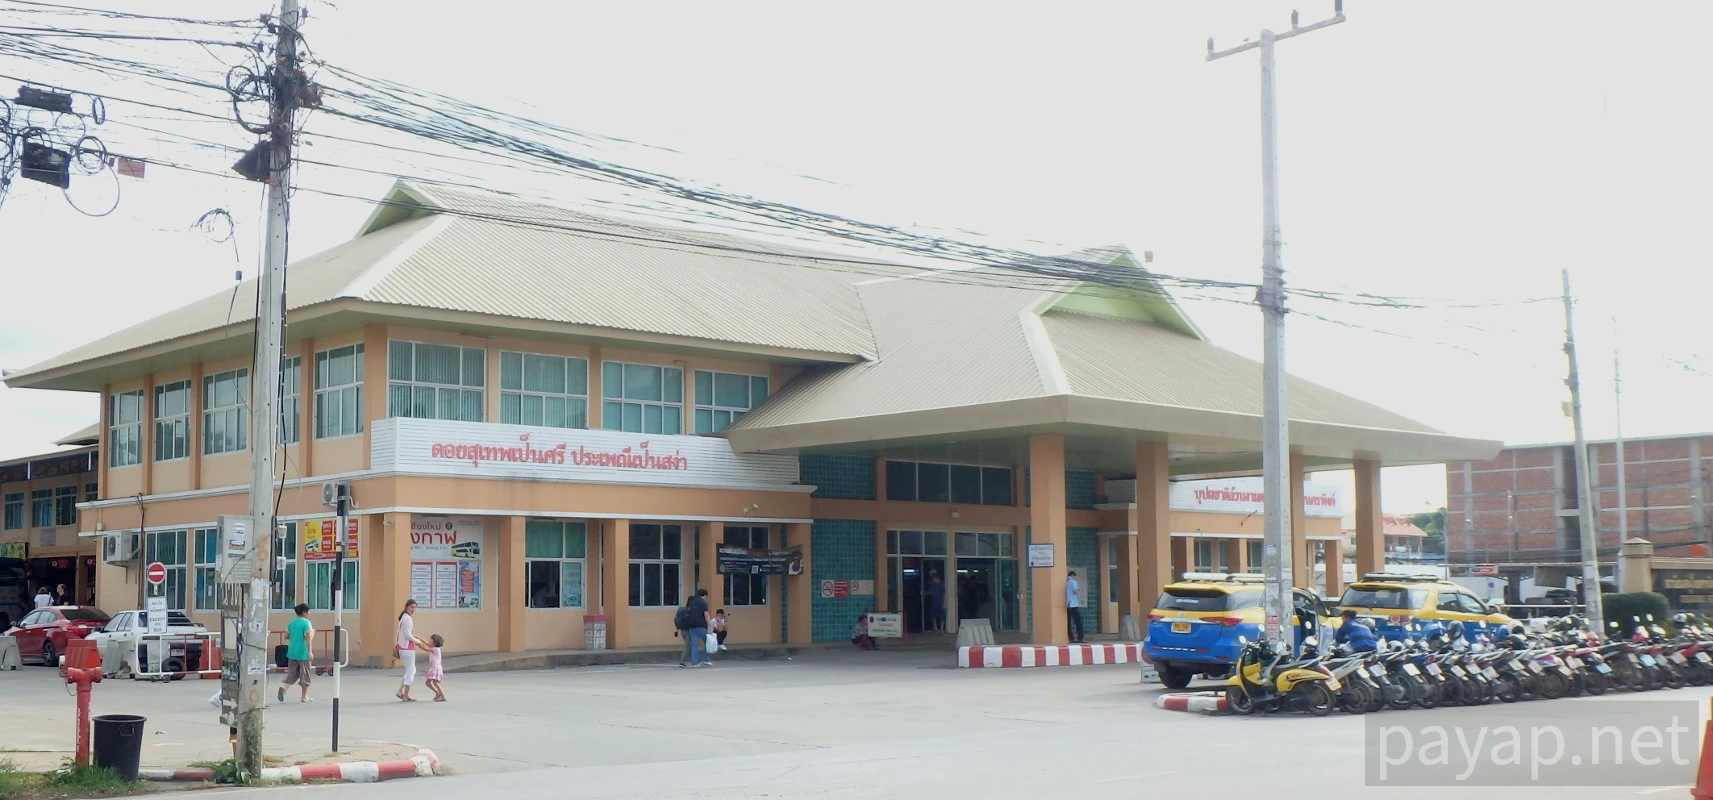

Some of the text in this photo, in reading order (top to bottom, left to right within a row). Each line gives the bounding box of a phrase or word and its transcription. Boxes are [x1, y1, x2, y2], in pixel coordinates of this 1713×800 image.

[432, 433, 688, 470] ดอยสุเทพเป็นศรี ประเพณีเป็นสง่า
[410, 530, 457, 545] งกาฬ
